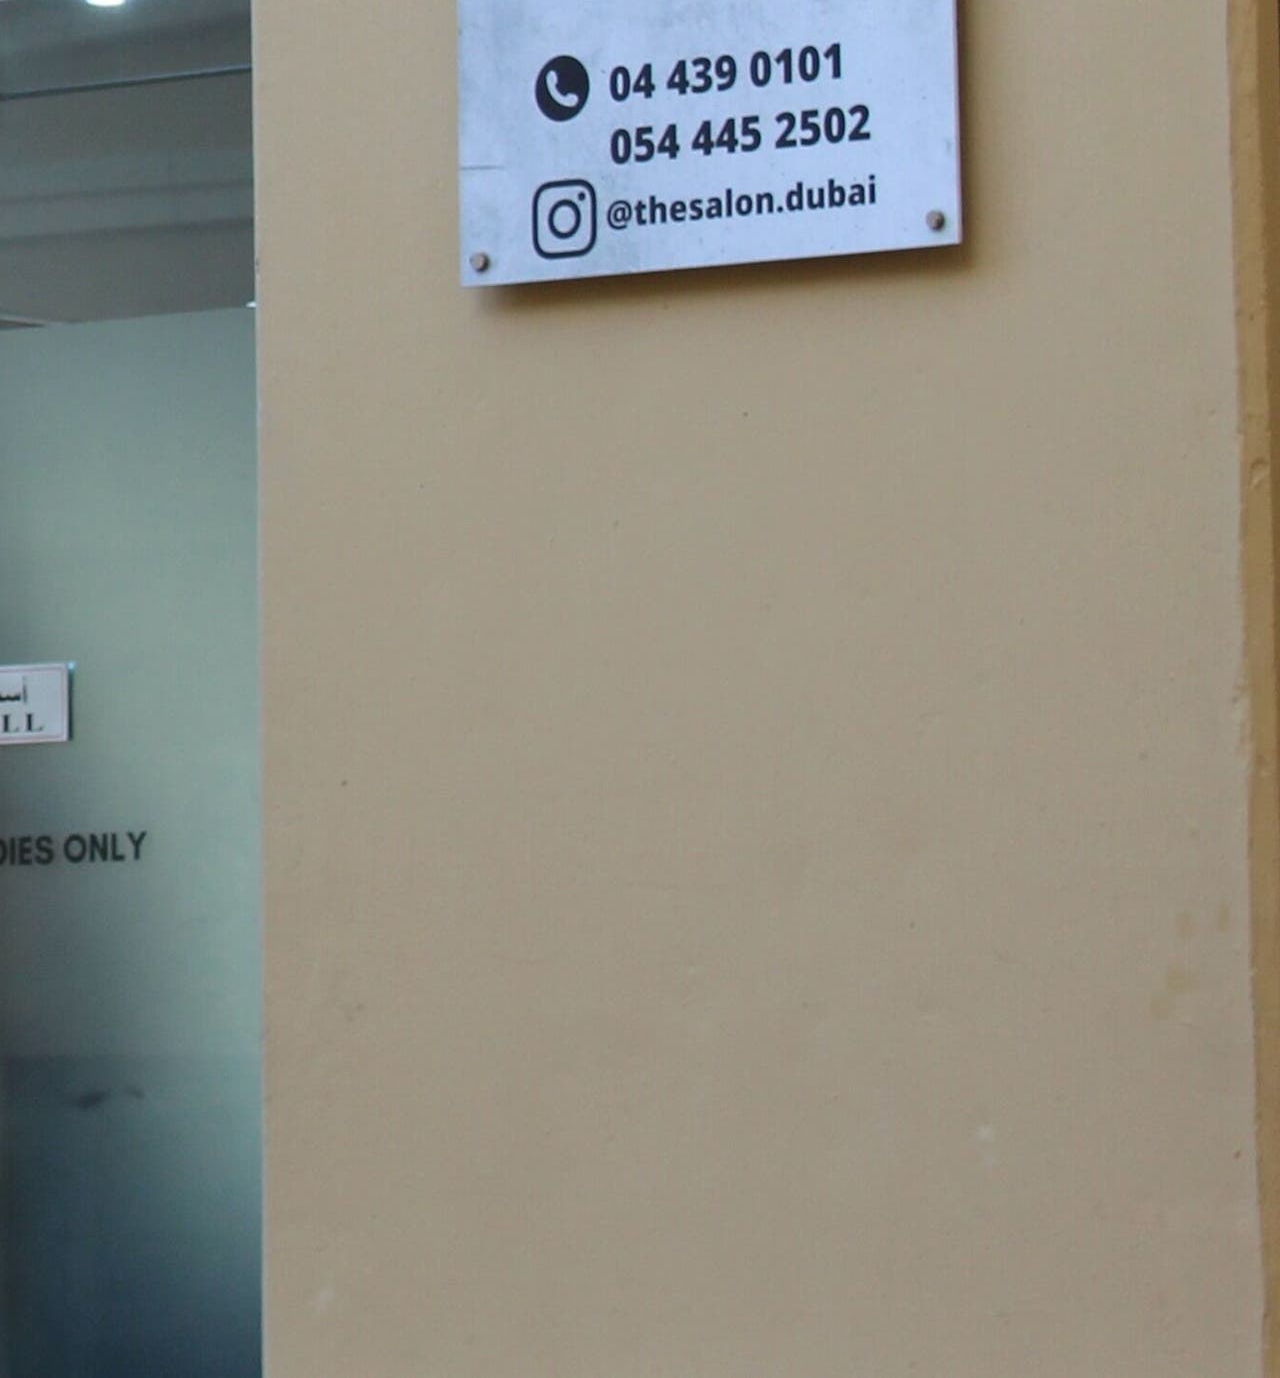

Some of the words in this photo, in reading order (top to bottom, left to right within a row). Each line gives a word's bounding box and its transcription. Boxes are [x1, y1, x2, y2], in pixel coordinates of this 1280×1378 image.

[608, 63, 656, 102] 04
[666, 54, 737, 96] 439
[750, 42, 842, 87] 0101
[609, 124, 680, 165] 054
[692, 115, 762, 157] 445
[774, 104, 871, 148] 2502
[606, 174, 877, 230] @thesalon.dubai
[63, 830, 147, 864] ONLY
